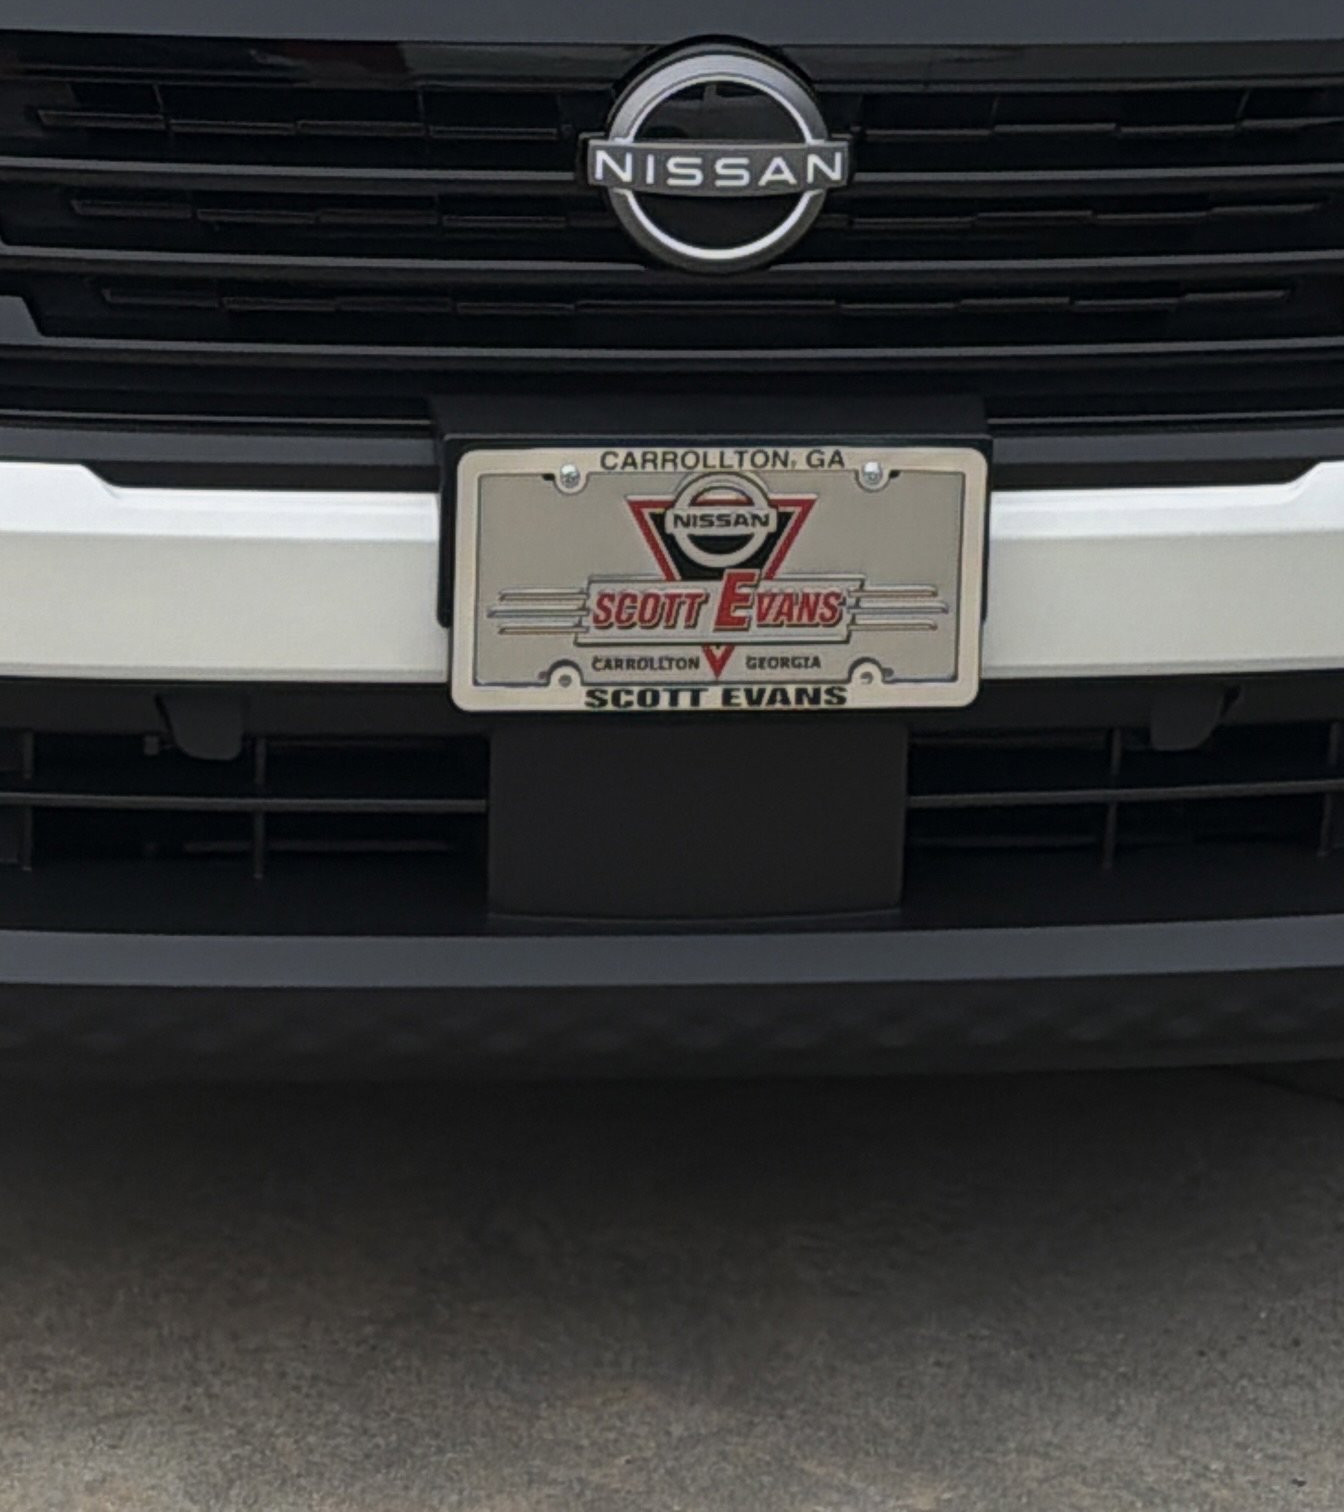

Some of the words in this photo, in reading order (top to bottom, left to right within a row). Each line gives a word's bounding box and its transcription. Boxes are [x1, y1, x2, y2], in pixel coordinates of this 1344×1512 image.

[593, 150, 843, 187] NISSAN
[805, 449, 846, 469] GA
[672, 511, 771, 529] NISSAN
[591, 589, 710, 629] SCOTT
[712, 569, 845, 632] EVANS
[591, 656, 700, 671] CARROLLTON
[745, 655, 822, 670] GEORGIA
[584, 688, 707, 708] SCOTT
[721, 687, 848, 707] EVANS
